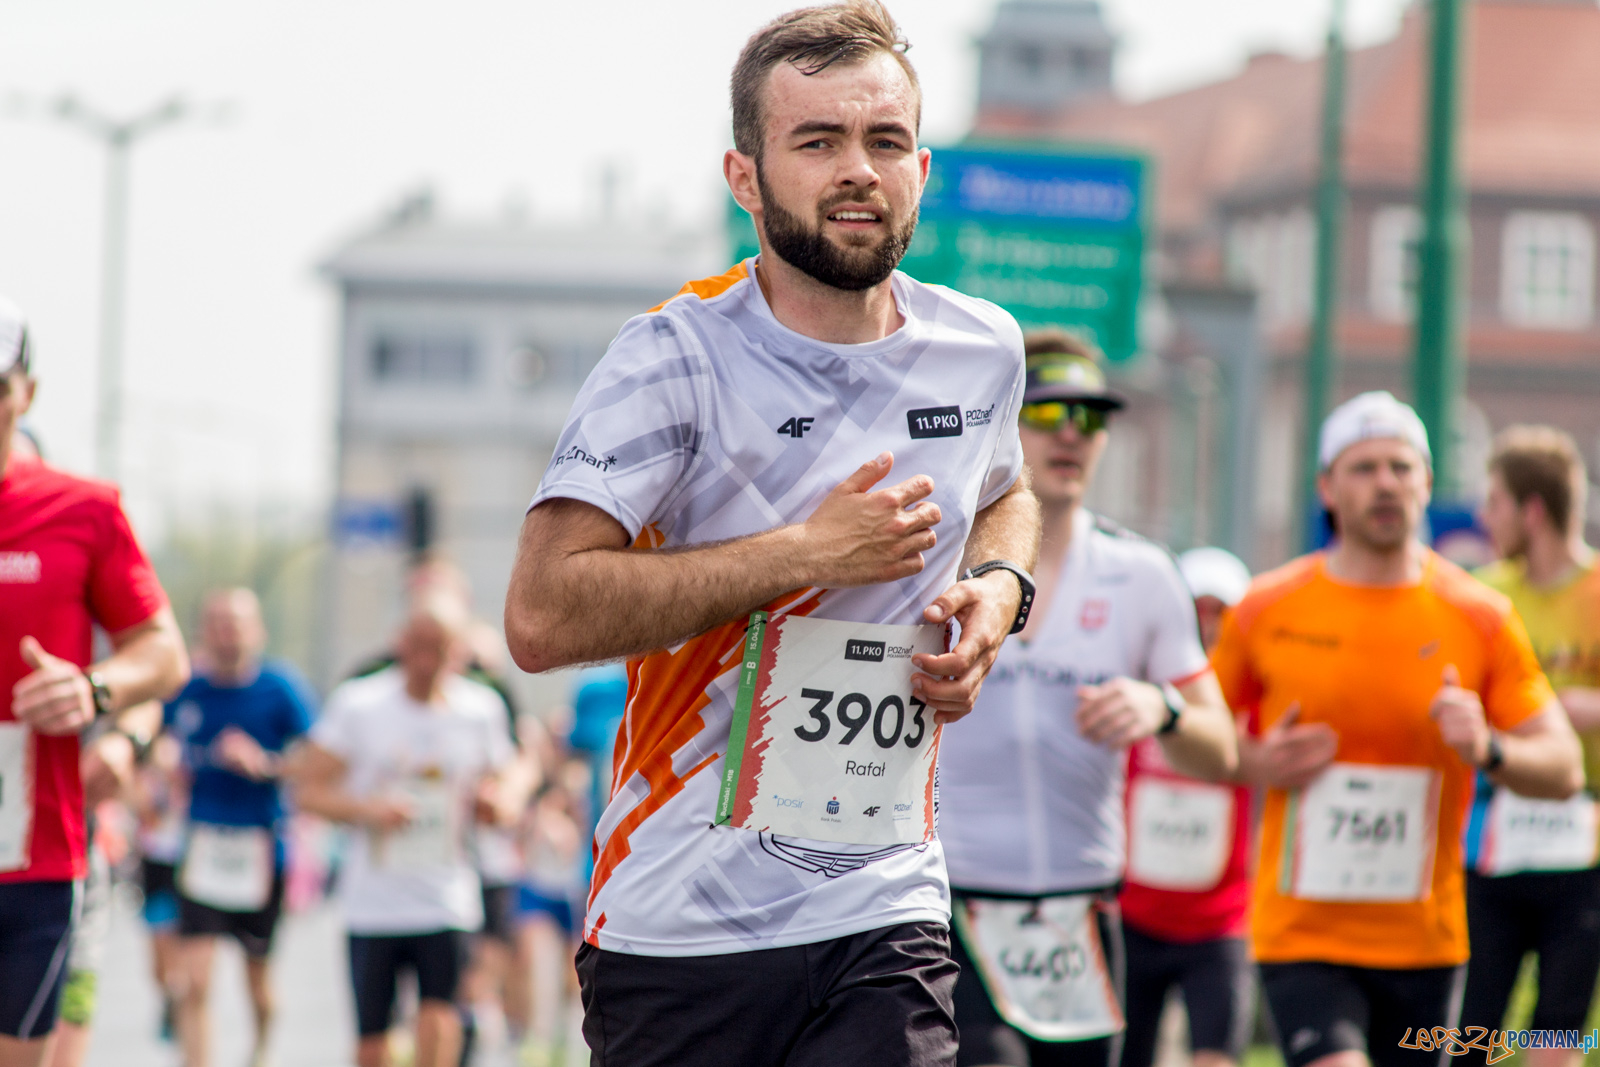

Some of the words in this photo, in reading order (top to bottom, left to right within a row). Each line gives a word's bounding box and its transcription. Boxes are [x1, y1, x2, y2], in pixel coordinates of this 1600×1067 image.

[777, 417, 815, 438] 4F
[850, 645, 882, 657] 11.PKO
[746, 661, 756, 669] B
[793, 687, 927, 749] 3903
[845, 760, 886, 777] Rafał
[720, 787, 731, 817] Buchalski
[862, 806, 881, 818] 4F
[1327, 807, 1409, 843] 7561
